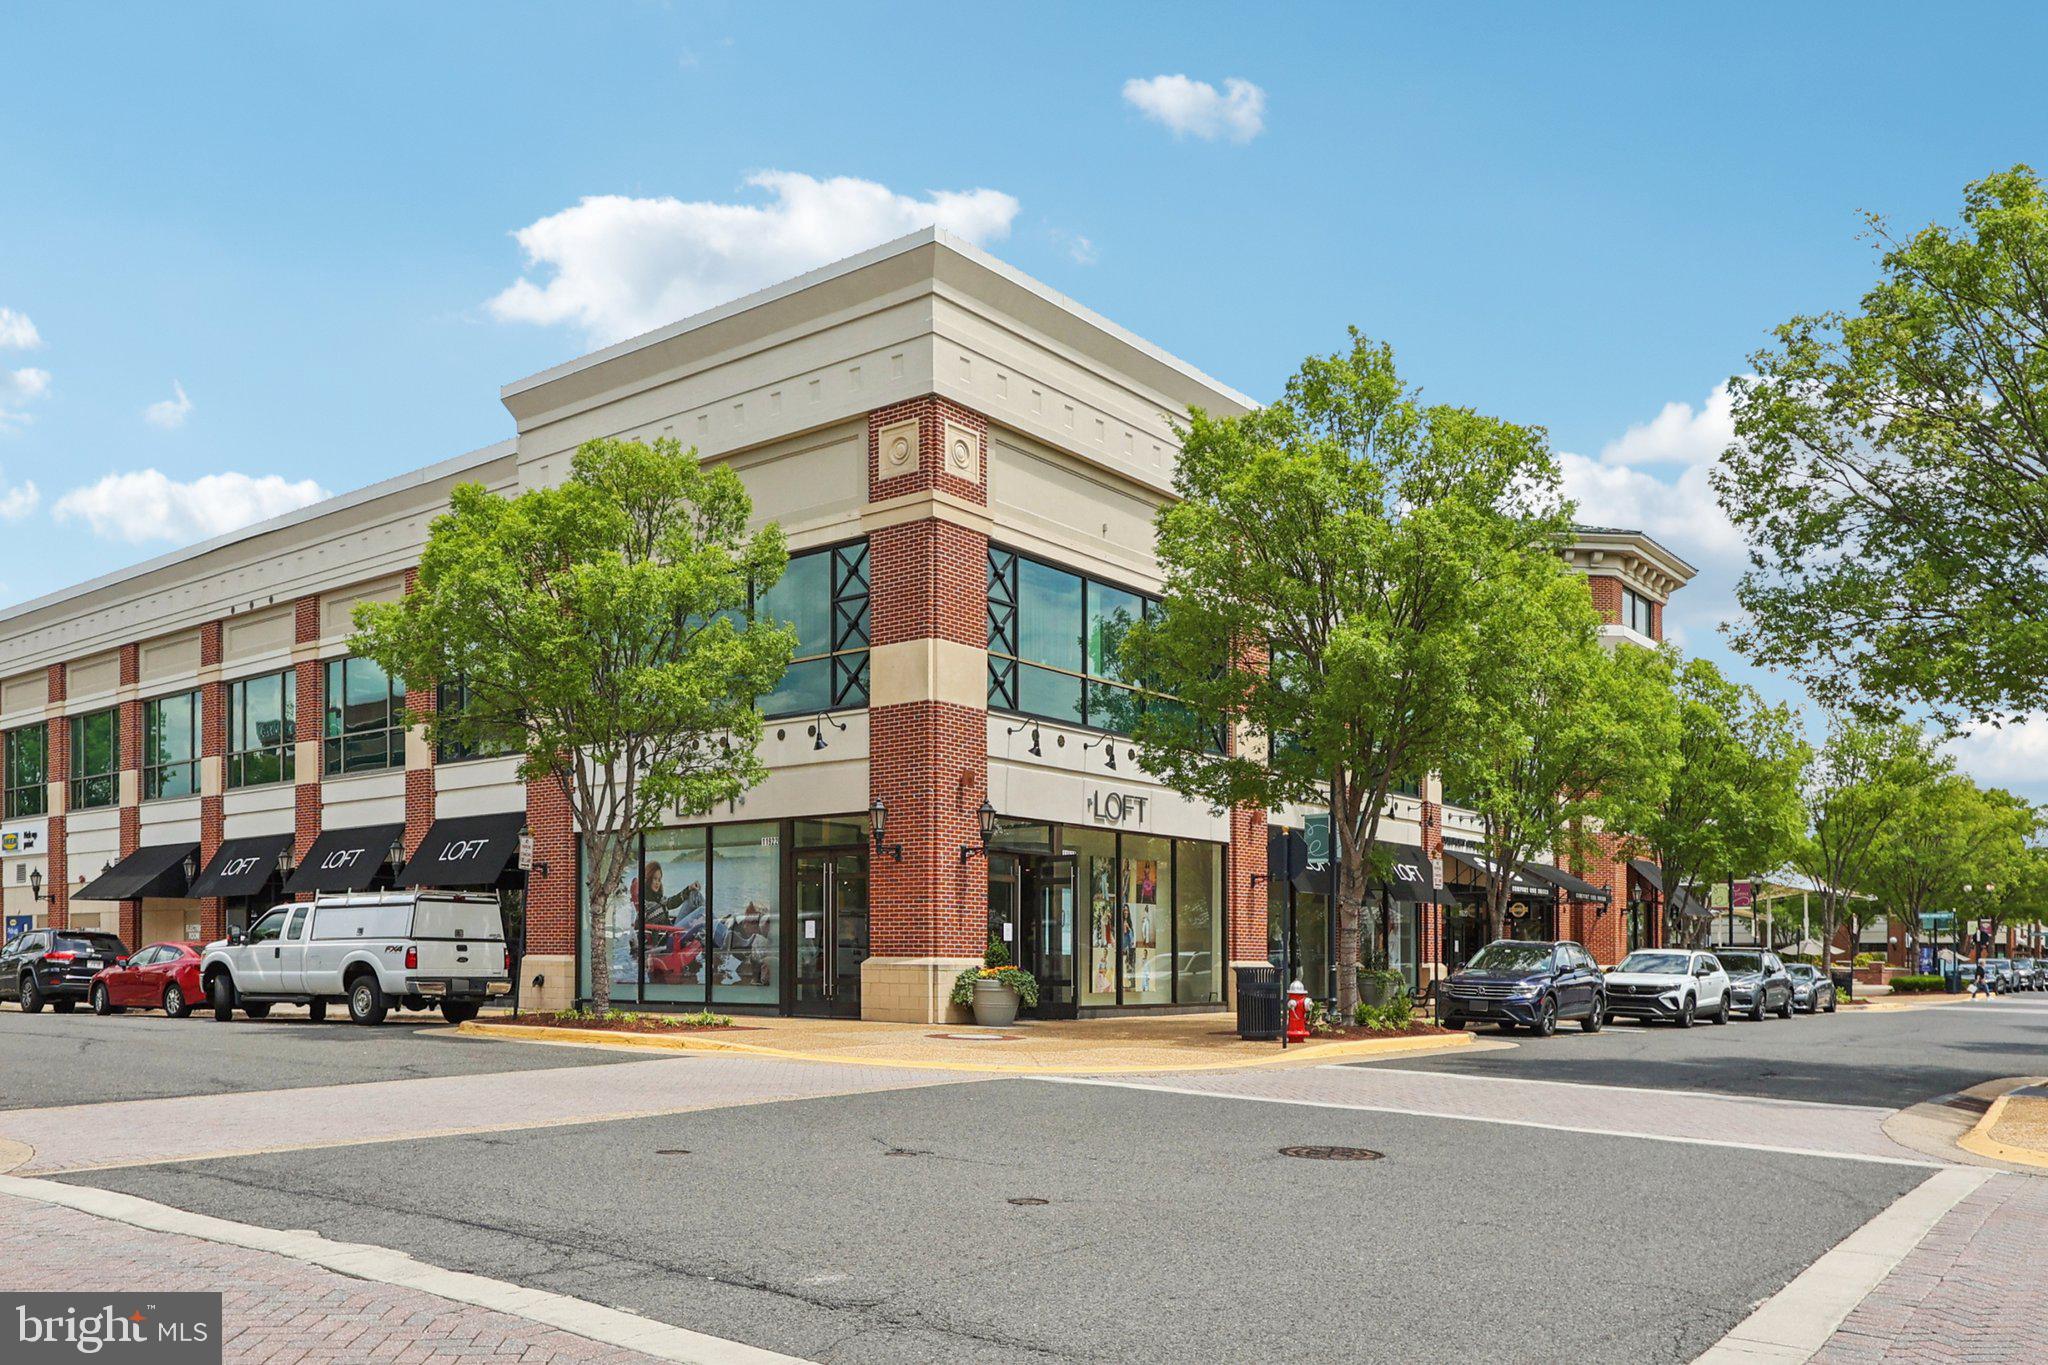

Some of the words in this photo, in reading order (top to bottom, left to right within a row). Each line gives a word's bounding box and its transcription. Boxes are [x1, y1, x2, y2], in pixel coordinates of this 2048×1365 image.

[1093, 790, 1149, 823] LOFT
[320, 848, 366, 870] LOFT
[438, 838, 490, 861] LOFT
[221, 857, 261, 876] LOFT
[1392, 862, 1425, 883] LOFT
[384, 945, 404, 953] FX4
